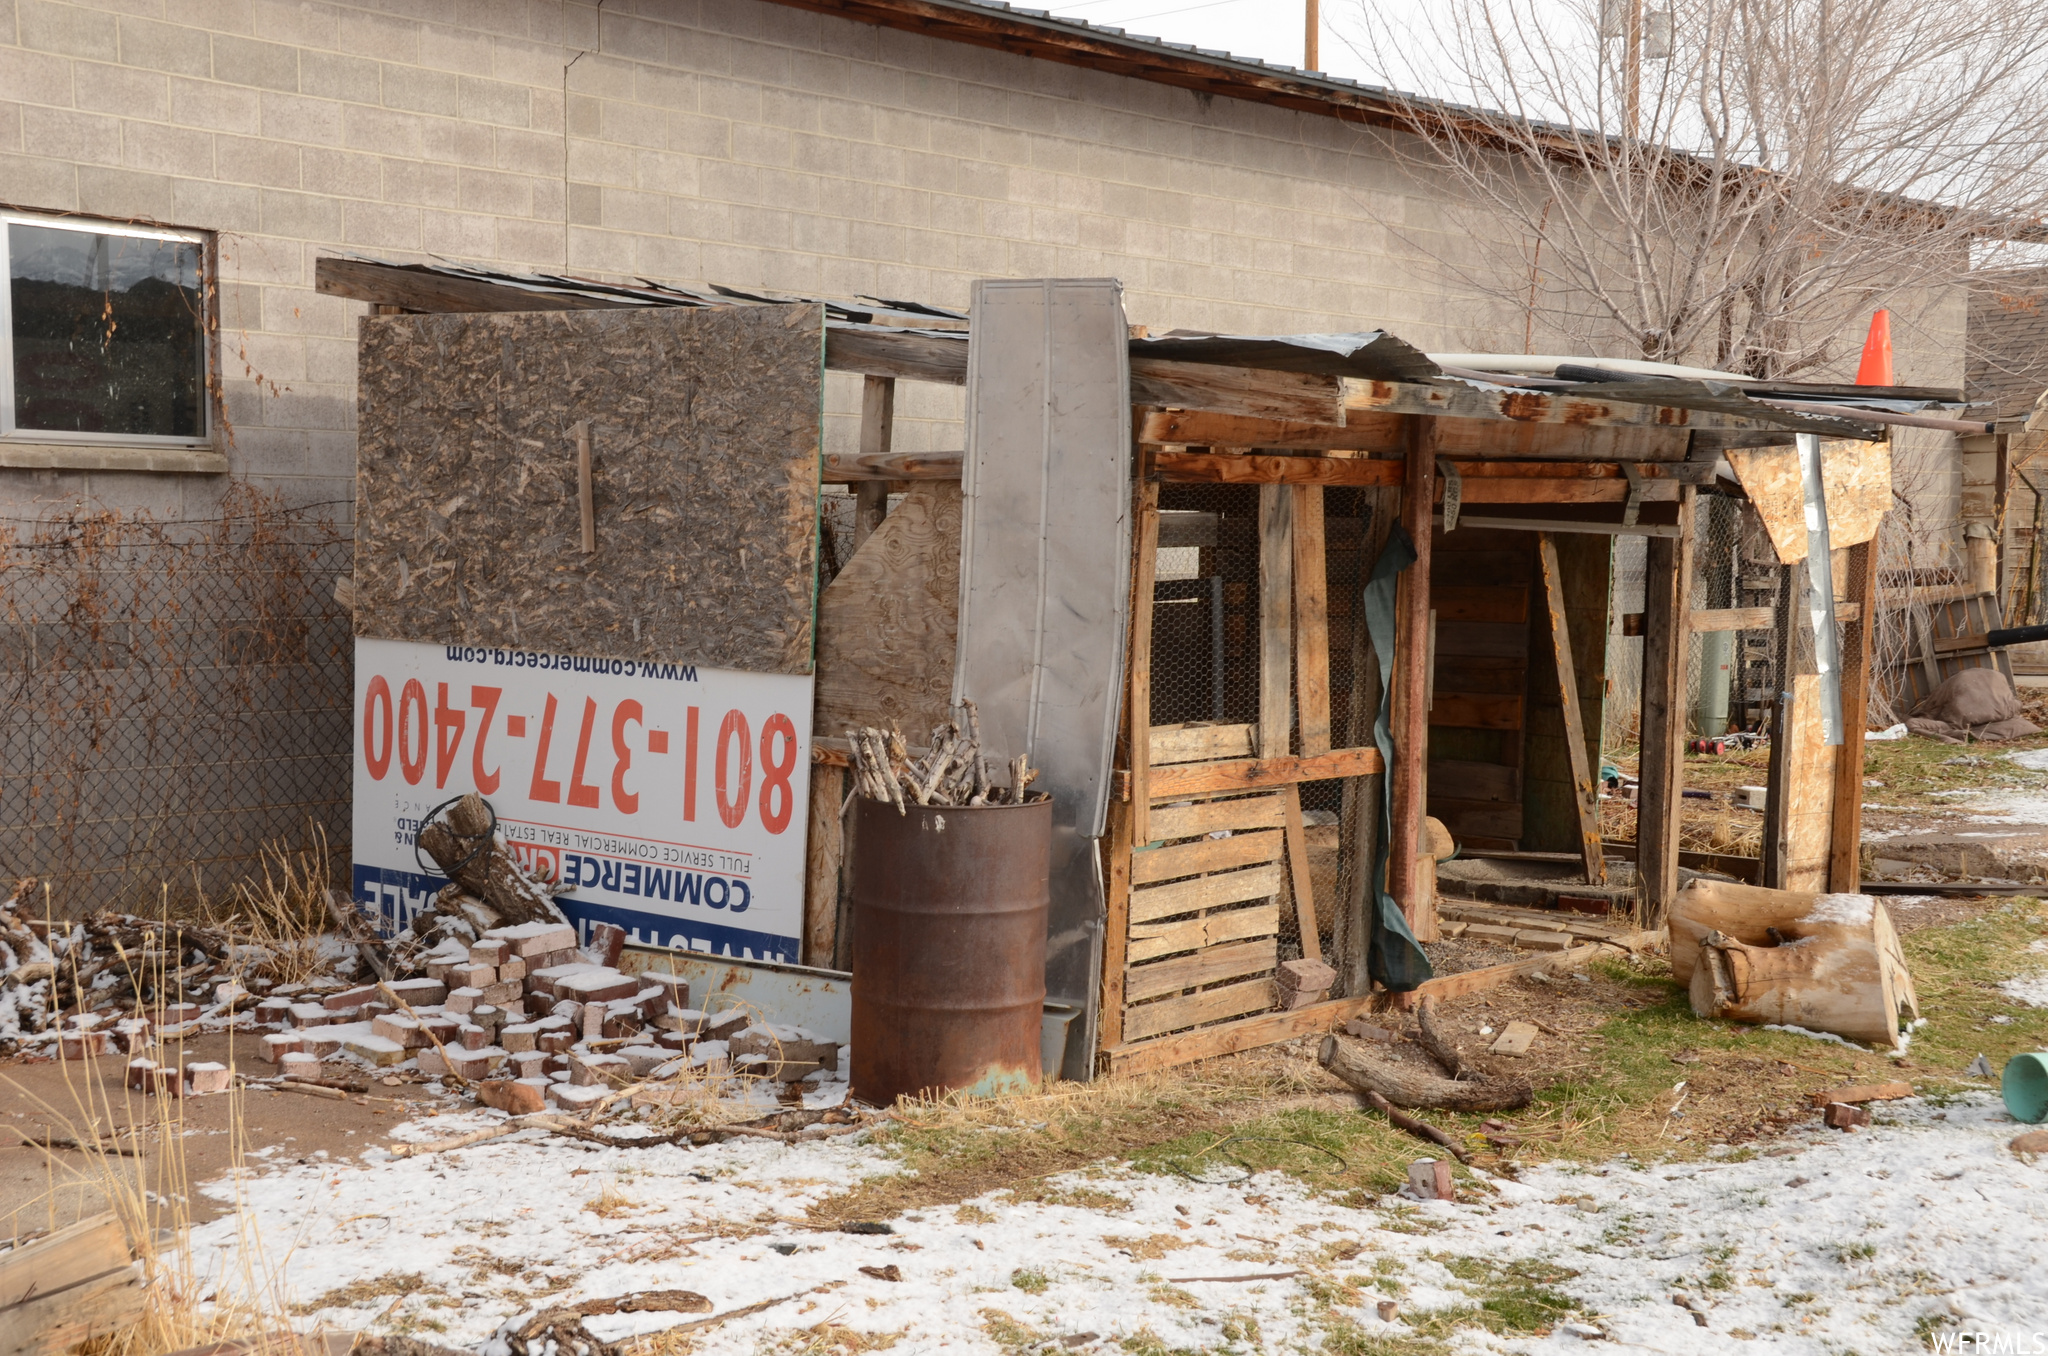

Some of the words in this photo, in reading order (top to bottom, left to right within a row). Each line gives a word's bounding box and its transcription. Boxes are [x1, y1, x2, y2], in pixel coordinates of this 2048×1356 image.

[363, 674, 797, 835] 801-377-2400
[541, 828, 570, 846] REAL
[574, 834, 658, 853] COMMERCIAL
[663, 847, 714, 868] SERVICE
[720, 855, 750, 873] FULL
[564, 854, 751, 913] COMMERCE
